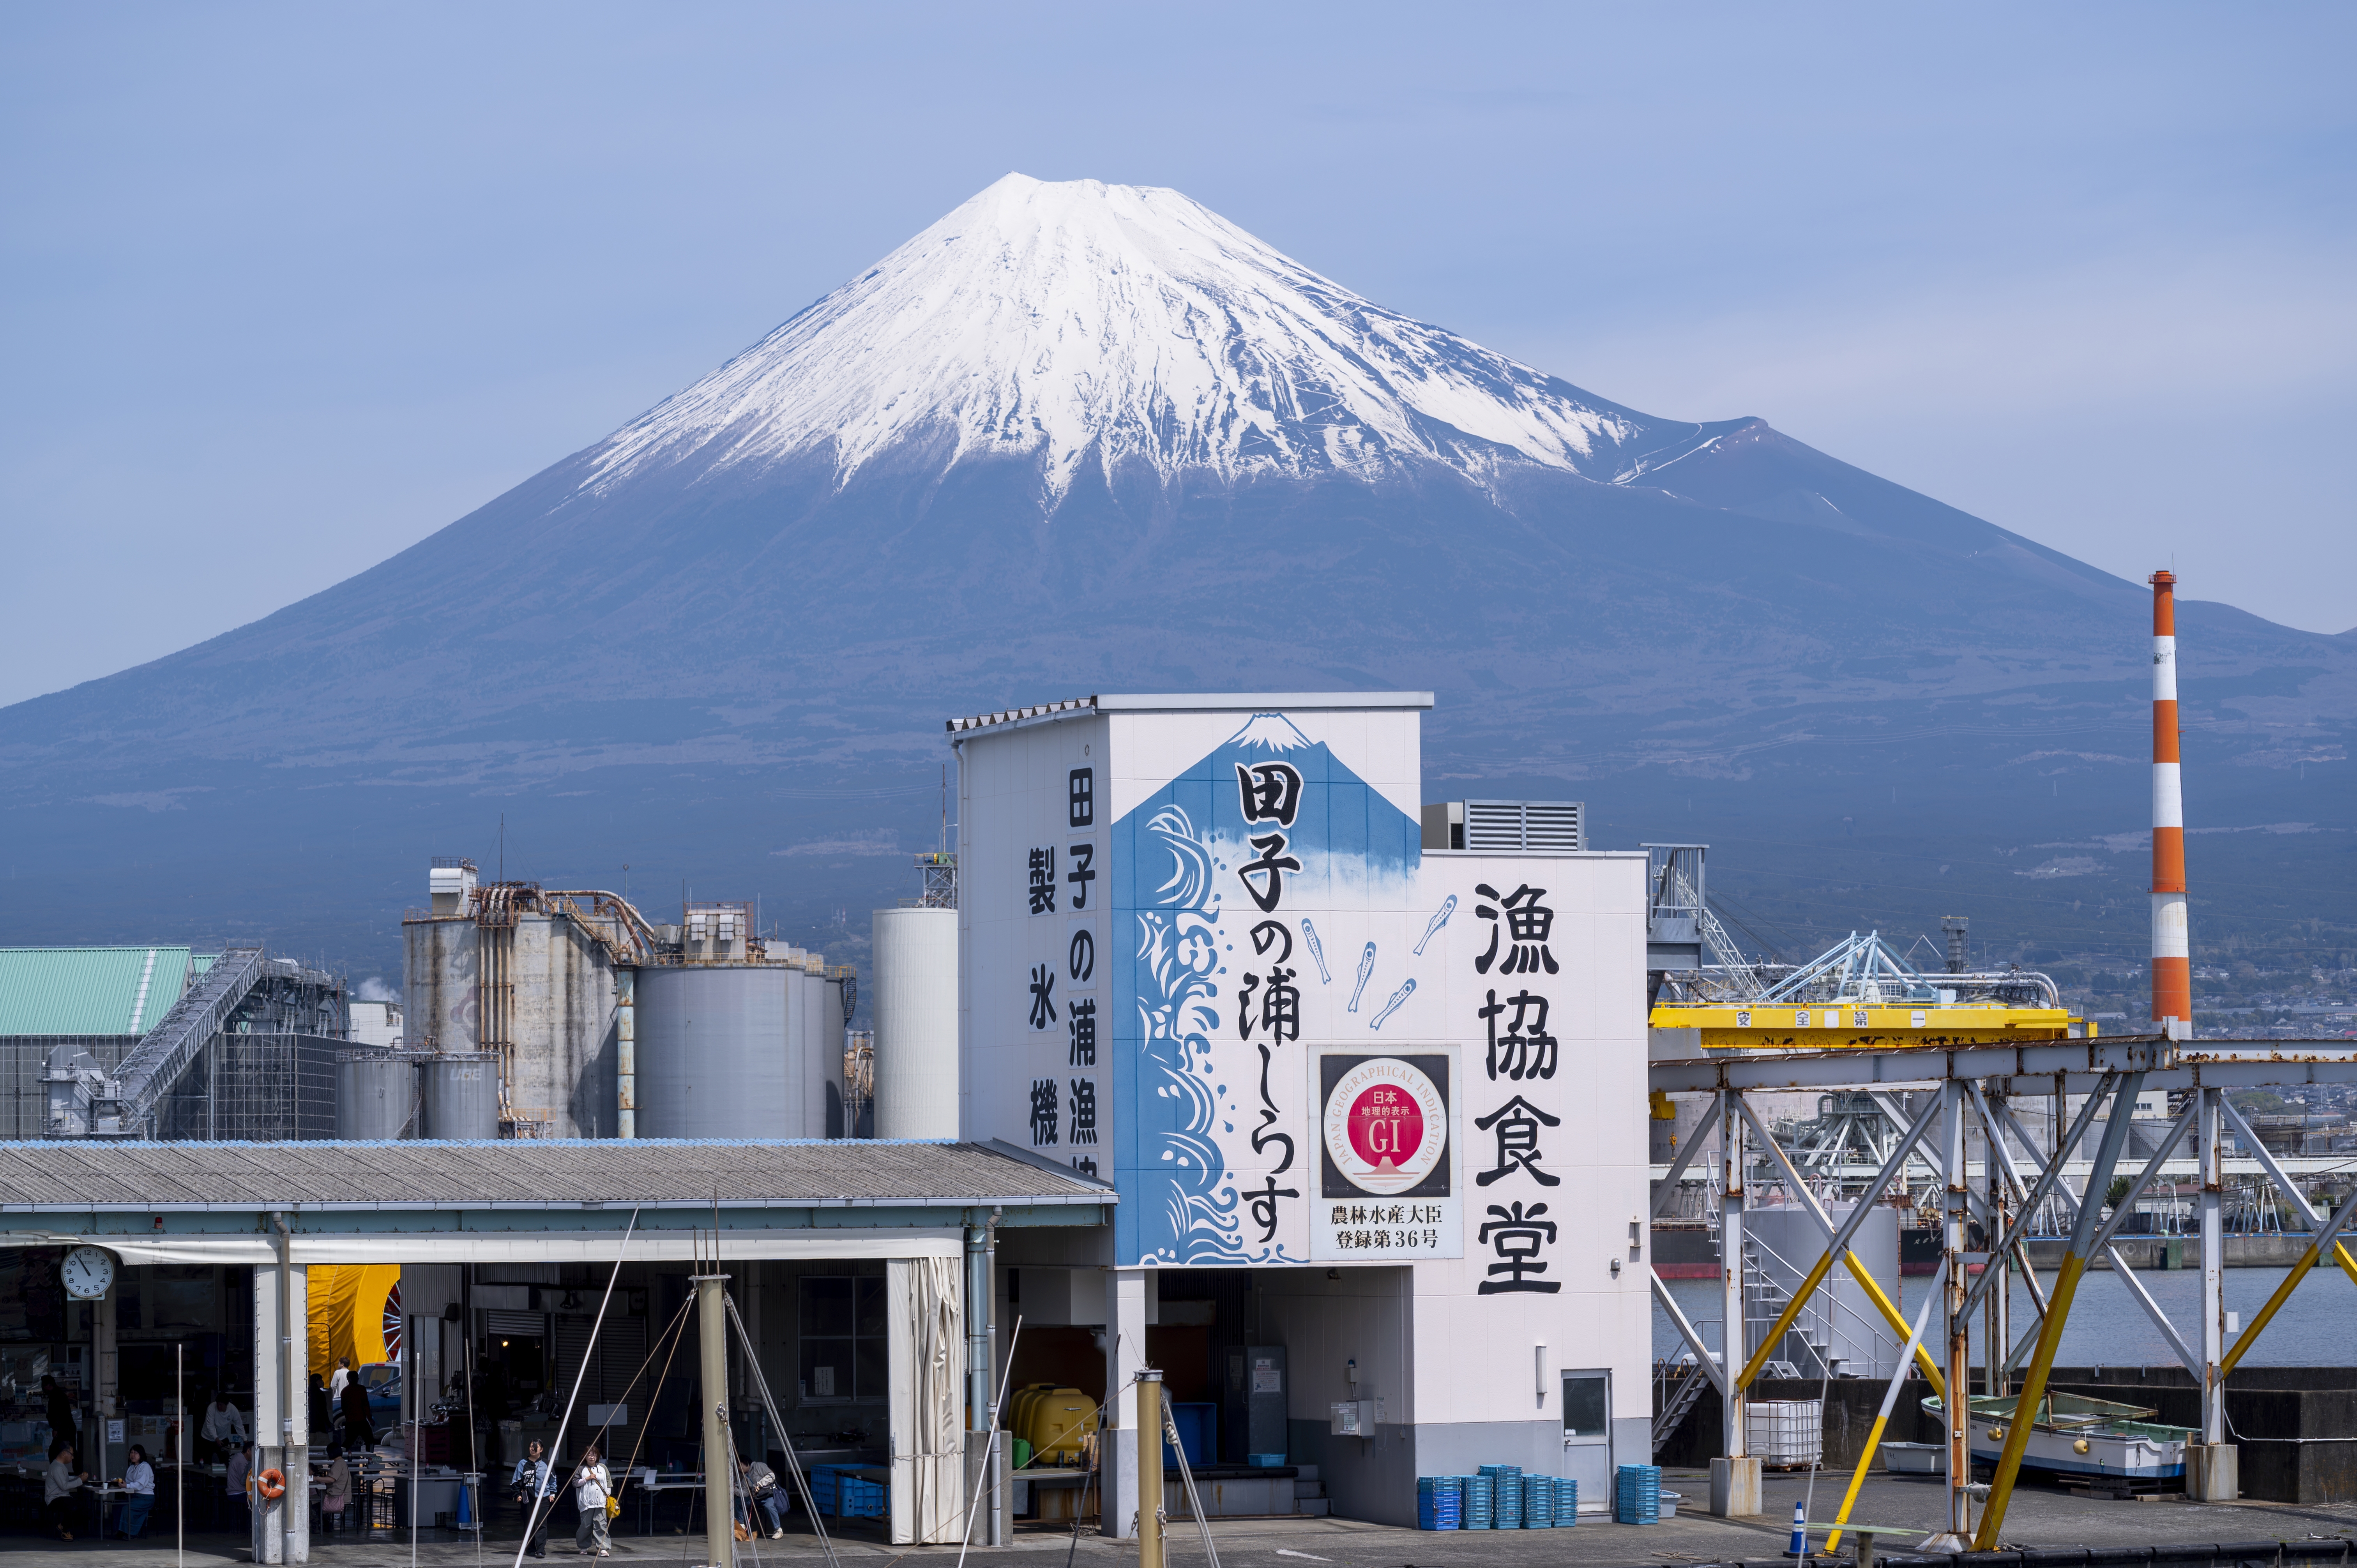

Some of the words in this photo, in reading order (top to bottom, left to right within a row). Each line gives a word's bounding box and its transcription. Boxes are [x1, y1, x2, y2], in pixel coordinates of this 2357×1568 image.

[1028, 846, 1058, 1146] 製氷機
[1237, 765, 1300, 1243] 田子の浦しらす
[1738, 1011, 1924, 1026] 安全第一
[450, 1068, 482, 1081] UBE
[1332, 1065, 1414, 1117] GEOGRAPHICAL
[1474, 883, 1561, 1295] 漁協食堂
[1361, 1106, 1410, 1116] 地理的表示
[1374, 1091, 1397, 1104] 日本
[1369, 1119, 1401, 1153] GI
[1416, 1082, 1440, 1165] INDICATION
[1331, 1123, 1353, 1165] JAPAN
[1331, 1205, 1442, 1225] 農林水産大臣
[1336, 1229, 1438, 1249] 登録第36号
